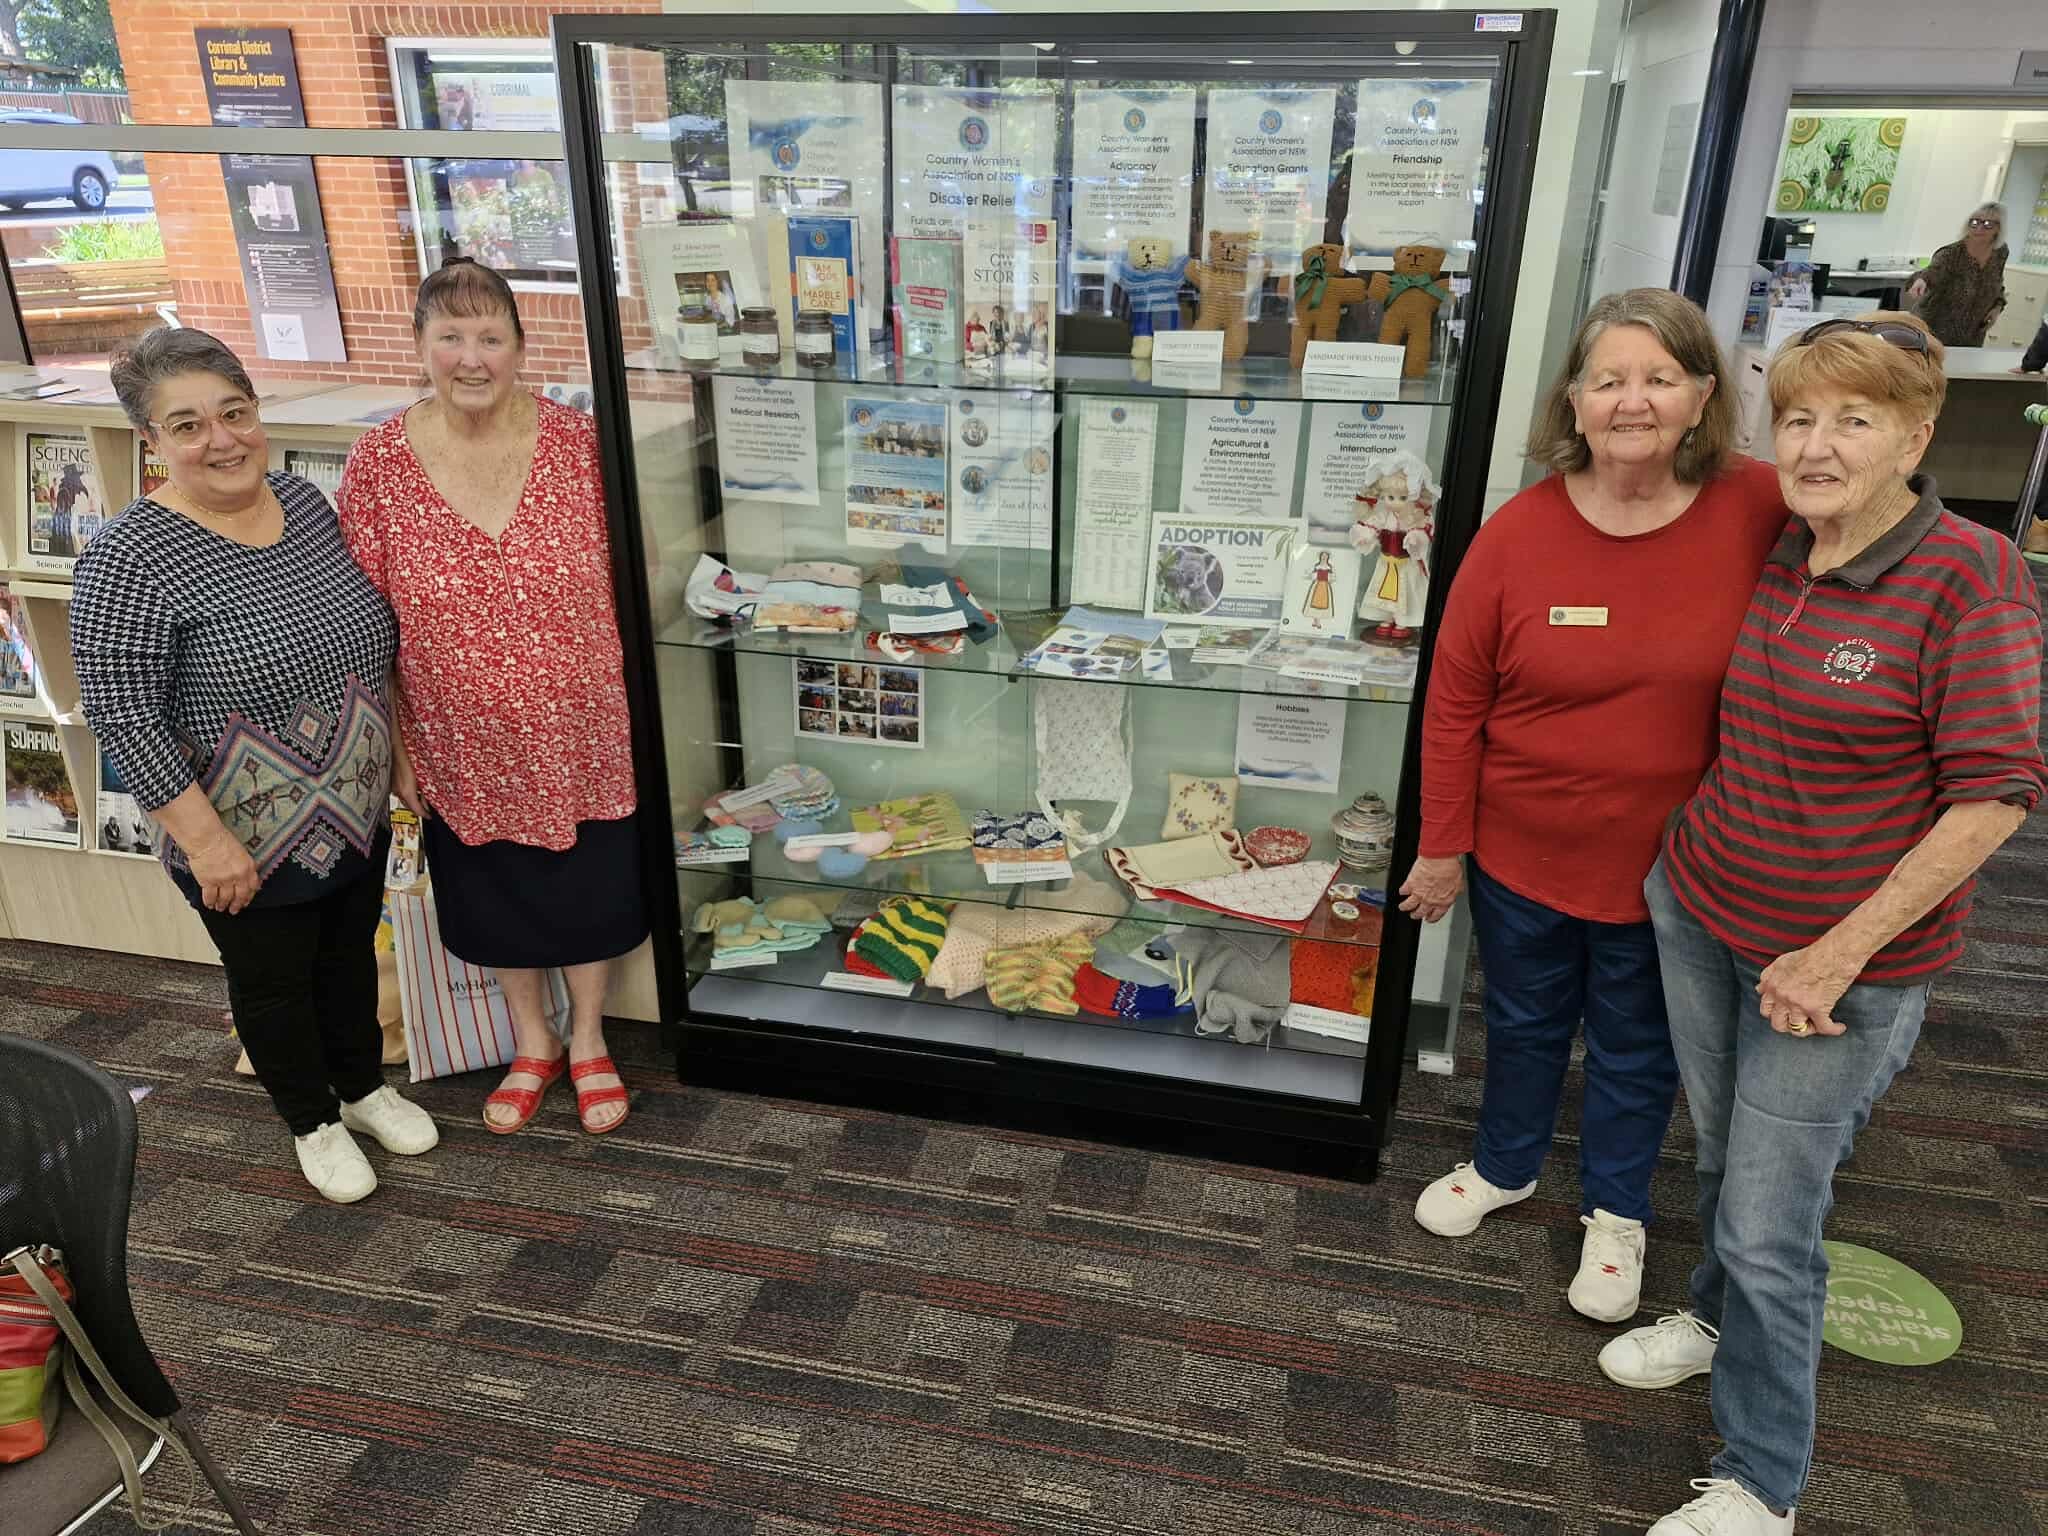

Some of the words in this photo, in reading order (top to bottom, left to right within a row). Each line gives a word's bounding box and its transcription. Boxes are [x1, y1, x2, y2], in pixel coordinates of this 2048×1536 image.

[207, 40, 241, 55] Corrimal
[241, 40, 272, 55] District
[210, 55, 238, 73] Library
[239, 55, 247, 70] &
[213, 72, 258, 89] Community
[258, 72, 286, 87] Centre
[1385, 126, 1418, 136] Country
[1234, 136, 1266, 145] Country
[1268, 136, 1304, 145] Women's
[1380, 138, 1429, 146] Association
[1430, 138, 1439, 146] of
[1440, 138, 1460, 146] NSW
[1231, 147, 1277, 156] Association
[1279, 147, 1288, 155] of
[1289, 147, 1306, 156] NSW
[926, 153, 969, 167] Country
[1392, 154, 1443, 165] Friendship
[1109, 161, 1157, 171] Advocacy
[1277, 163, 1309, 173] Grants
[986, 171, 998, 182] of
[929, 191, 979, 206] Disaster
[911, 215, 937, 226] Funds
[974, 268, 1040, 285] STORS
[803, 289, 841, 300] MARBLE
[810, 299, 837, 308] CAKE
[730, 407, 762, 417] Medical
[764, 409, 800, 421] Research
[1210, 416, 1241, 425] Country
[1242, 417, 1275, 427] Women's
[1338, 422, 1368, 431] Country
[1370, 423, 1404, 431] Women's
[1208, 424, 1250, 433] Association
[1250, 426, 1258, 434] of
[1260, 427, 1277, 435] NSW
[1334, 431, 1378, 440] Association
[1379, 432, 1388, 440] of
[1389, 433, 1406, 441] NSW
[1211, 437, 1261, 449] Agricultural
[35, 446, 90, 463] SCIENC
[1209, 448, 1271, 460] Environmental
[144, 464, 169, 478] AME
[290, 460, 344, 479] TRAVELL
[1160, 527, 1264, 547] ADOPTION
[36, 560, 62, 569] Science
[1846, 638, 1875, 654] ACTIVE
[1833, 650, 1867, 673] 62
[1856, 660, 1876, 681] WEAR
[1275, 703, 1310, 713] Hobbies
[447, 975, 497, 993] MyHou
[1873, 1316, 1952, 1340] start
[1840, 1327, 1921, 1354] Let's
